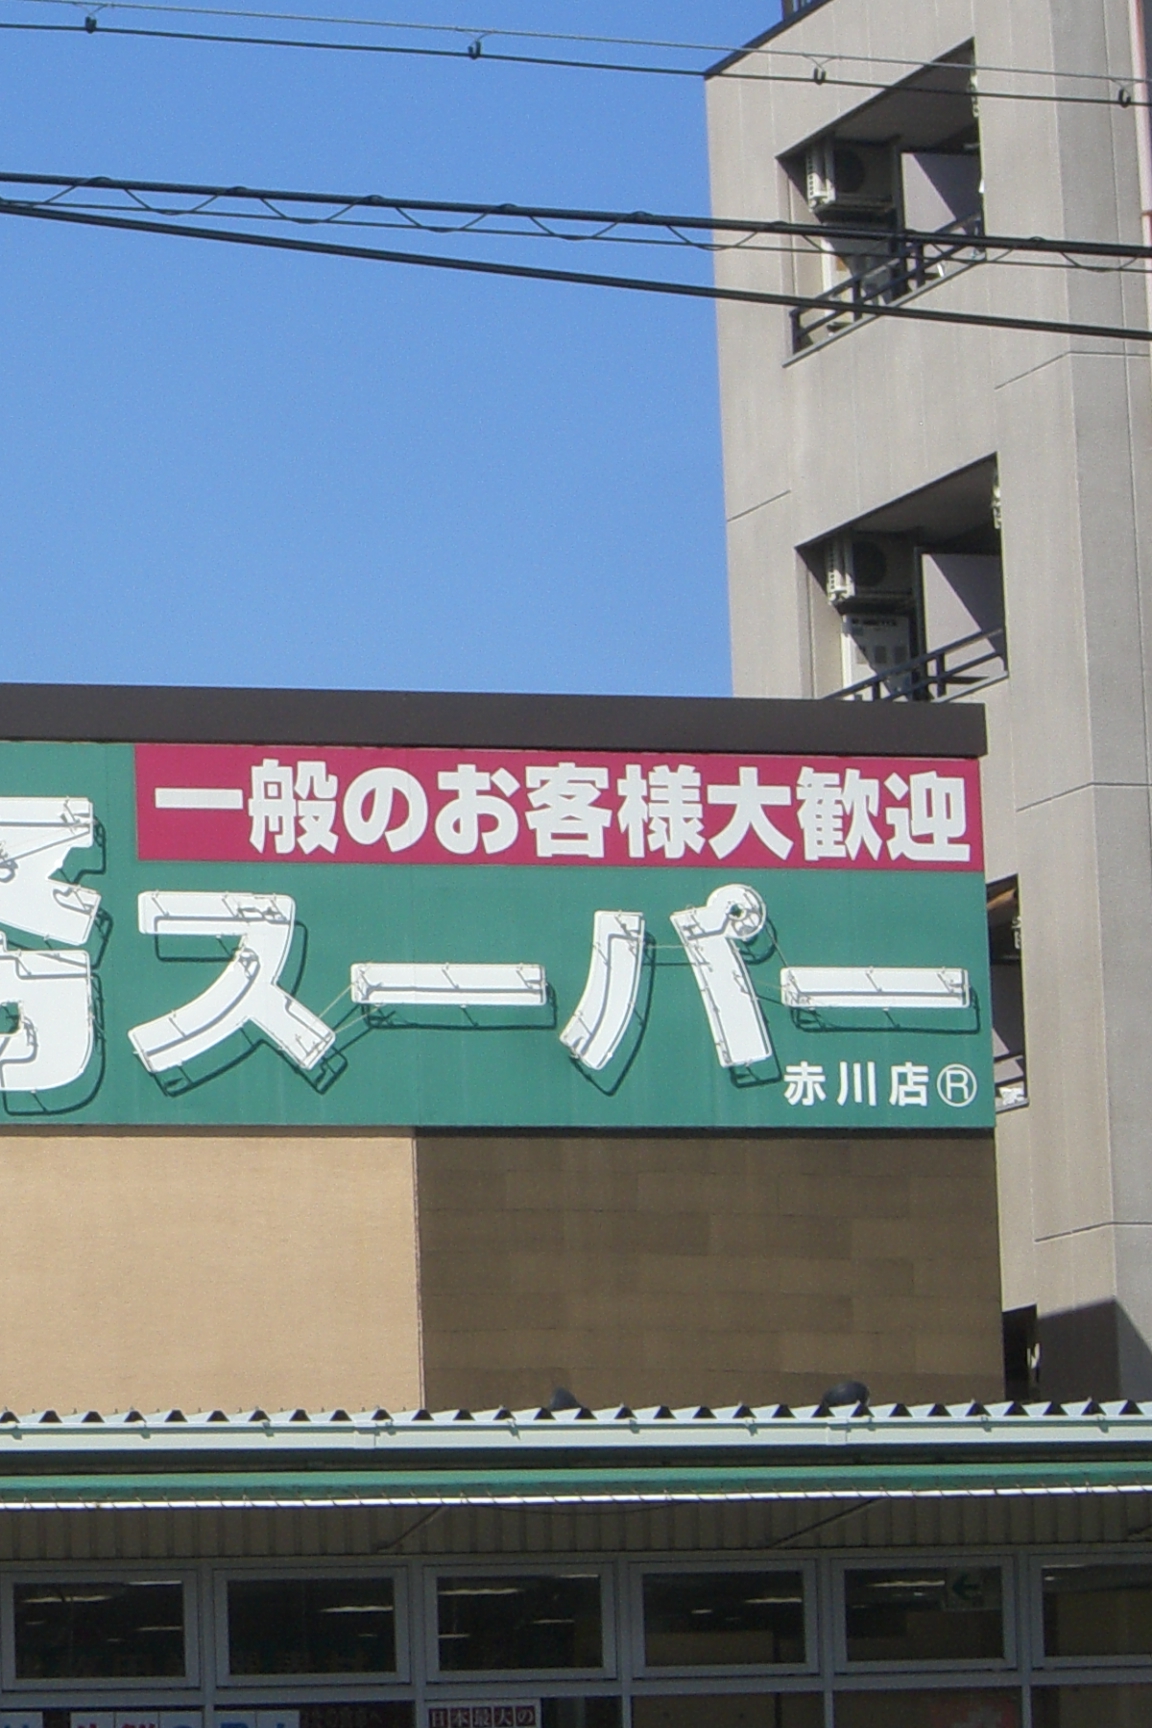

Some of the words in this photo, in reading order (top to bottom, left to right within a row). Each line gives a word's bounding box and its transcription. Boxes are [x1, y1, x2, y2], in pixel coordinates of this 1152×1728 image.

[154, 758, 972, 862] 一般のお客様大歓迎
[783, 1060, 929, 1107] 赤川店
